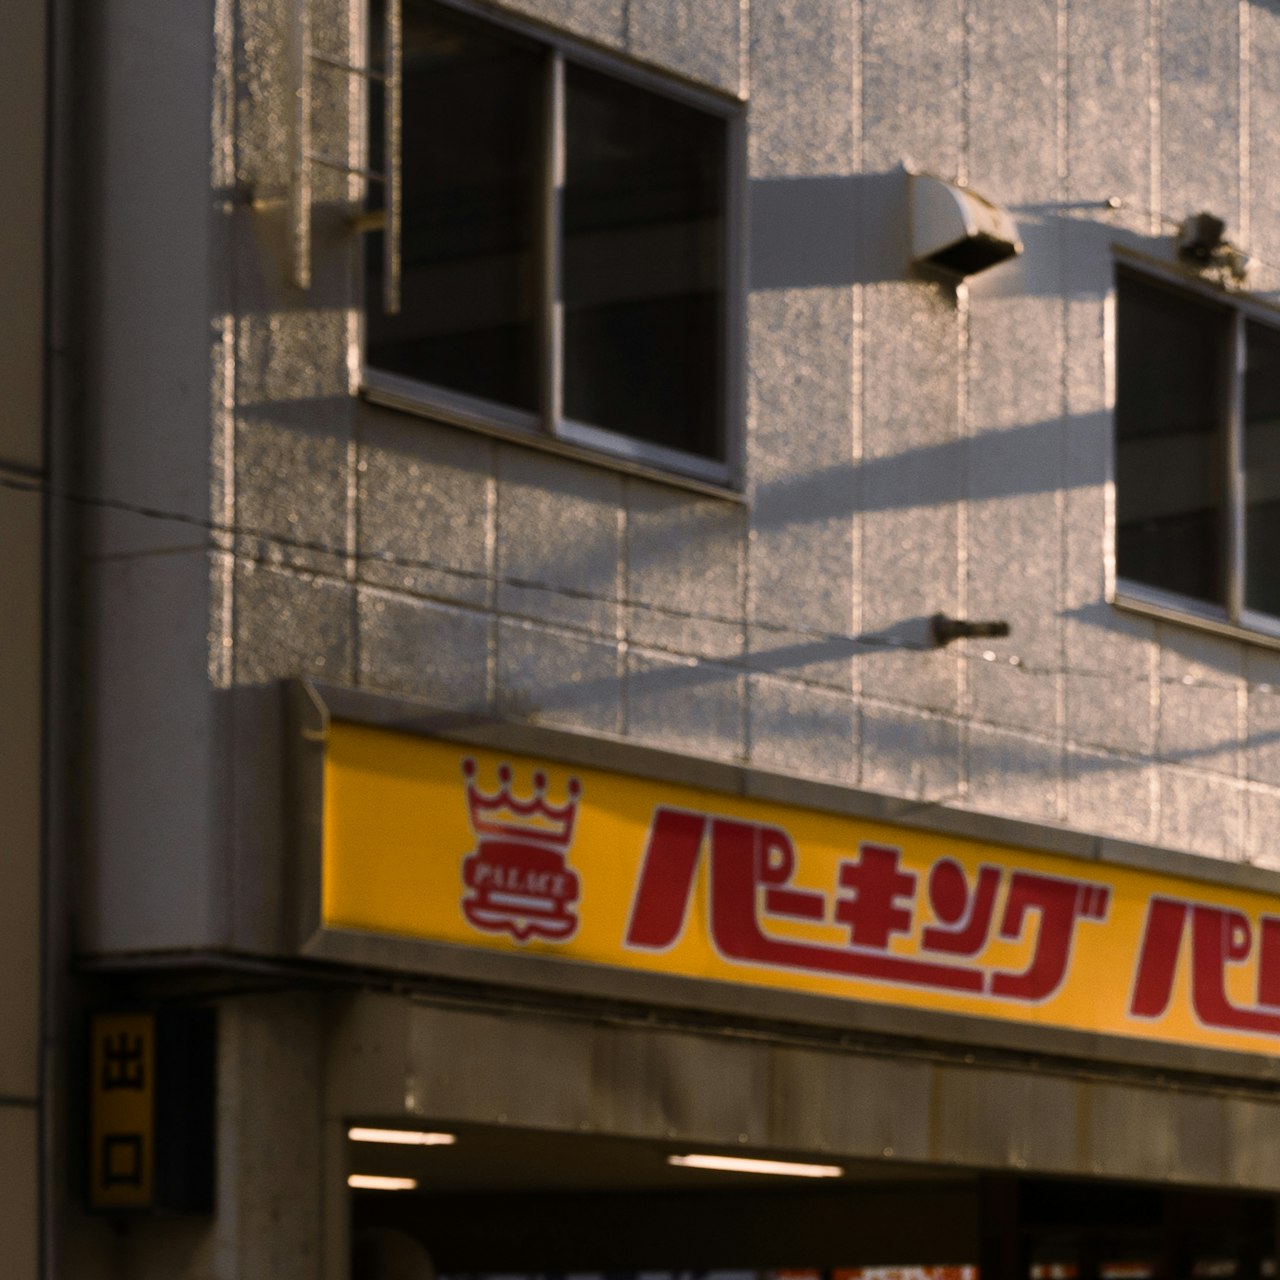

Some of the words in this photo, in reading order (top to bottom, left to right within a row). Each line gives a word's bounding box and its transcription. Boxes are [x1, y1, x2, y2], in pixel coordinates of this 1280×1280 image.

[623, 804, 1111, 1004] パーキング
[101, 1033, 144, 1189] 出口
